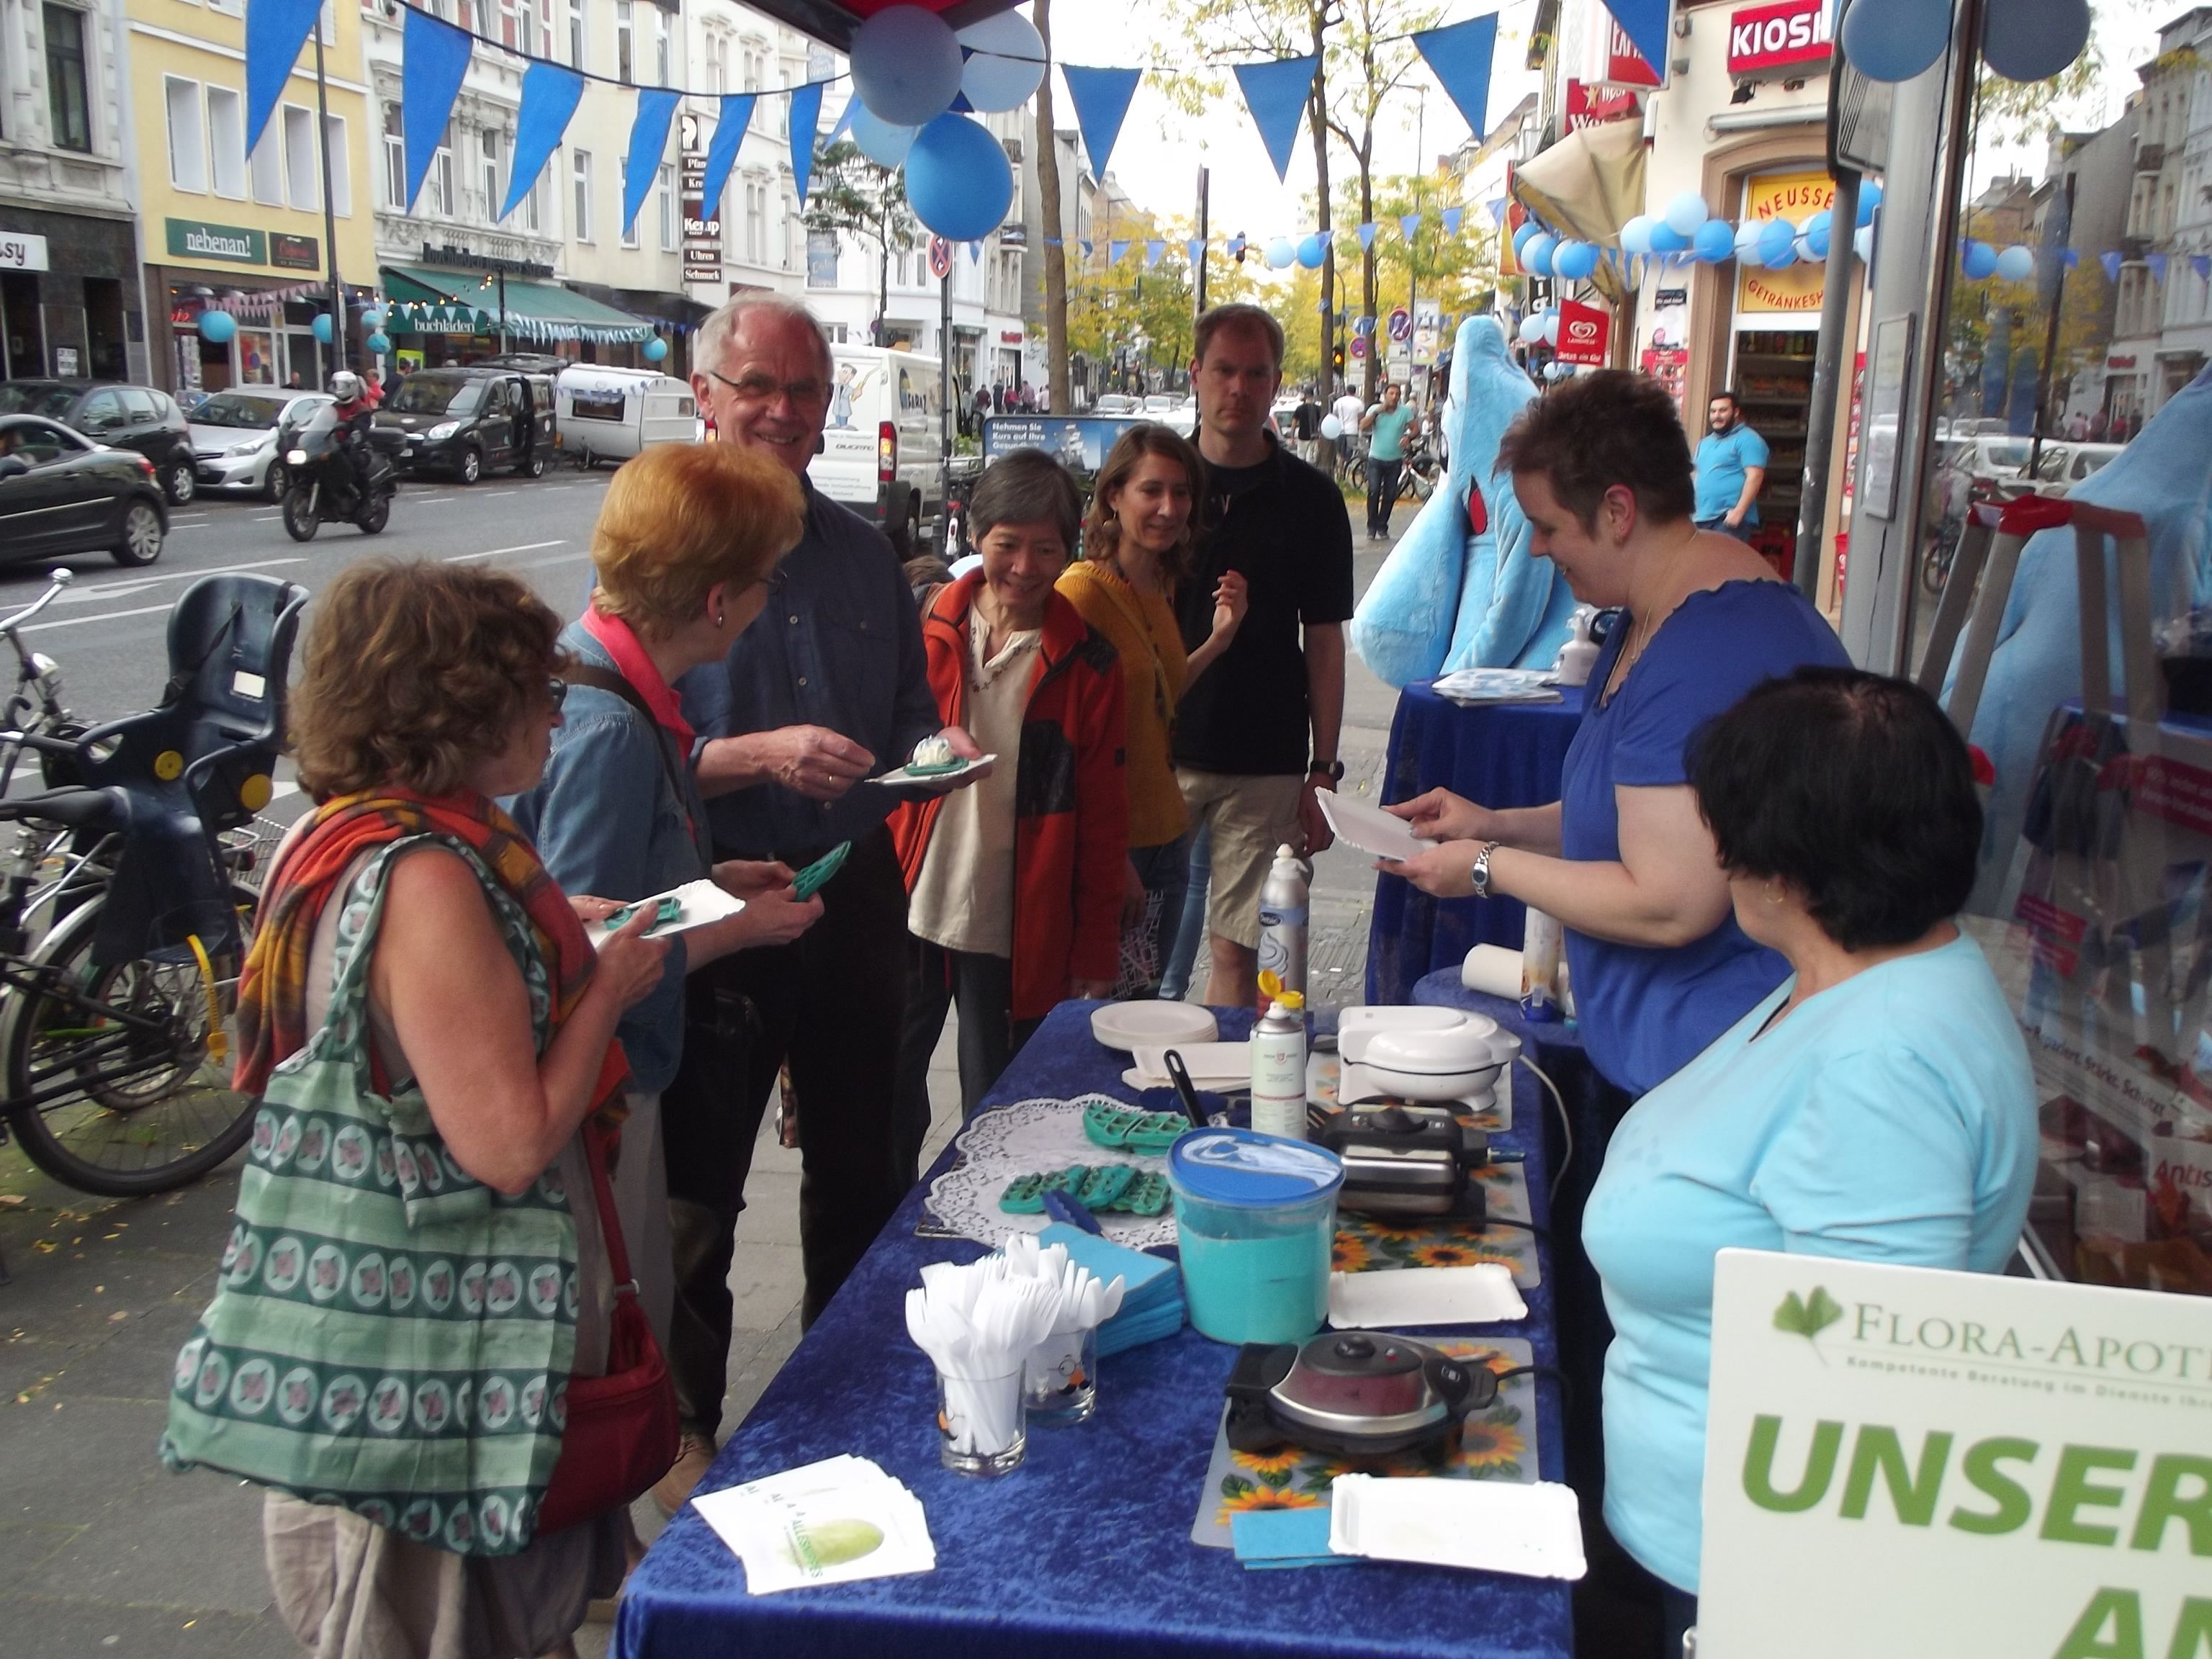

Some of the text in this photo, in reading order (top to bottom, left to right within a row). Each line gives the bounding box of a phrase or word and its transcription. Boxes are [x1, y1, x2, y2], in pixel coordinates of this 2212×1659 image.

[688, 159, 707, 169] Pfan
[186, 227, 252, 258] nebenan!
[0, 242, 25, 266] sy
[690, 250, 715, 261] Uhren
[685, 269, 721, 281] Schmuck
[414, 317, 476, 333] buchladen
[992, 422, 1043, 431] Nehmen Sie
[992, 431, 1046, 441] Kurs auf Ihre
[1853, 1302, 2212, 1379] FLORA-APOT
[1846, 1356, 2212, 1409] Kompetente Beratung im Dienste Ihr
[1741, 1413, 2212, 1558] UNSER
